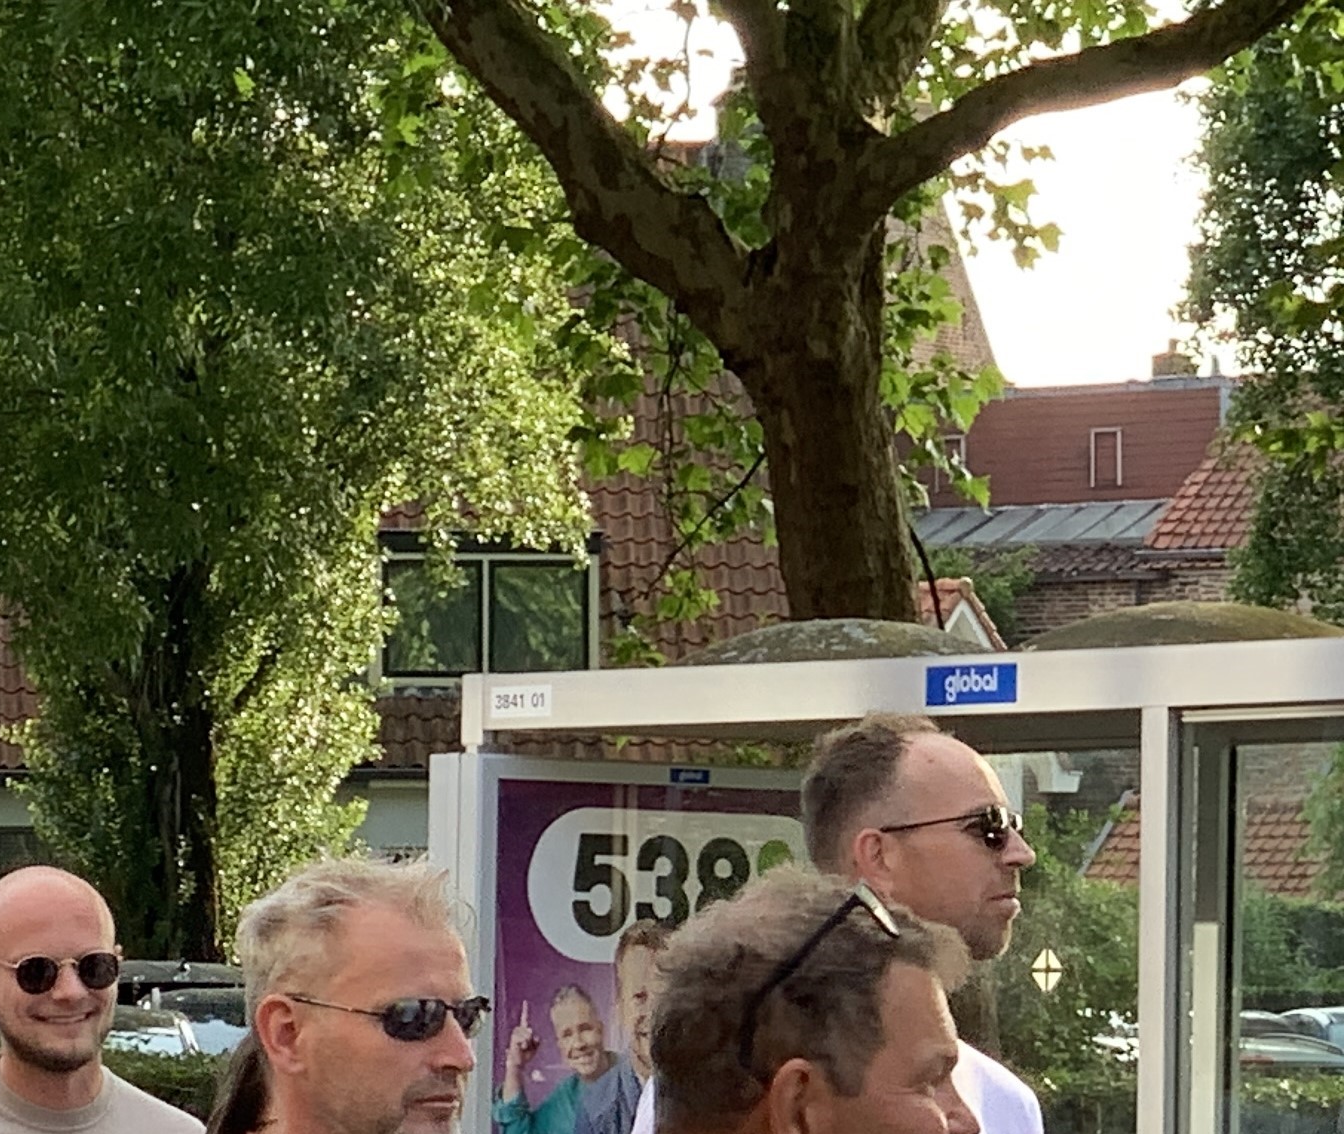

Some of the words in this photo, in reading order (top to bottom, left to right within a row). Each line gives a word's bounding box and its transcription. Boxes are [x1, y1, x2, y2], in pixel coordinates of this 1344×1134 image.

[495, 693, 524, 709] 3841
[531, 691, 545, 708] 01
[944, 665, 999, 702] global
[572, 833, 751, 937] 538
